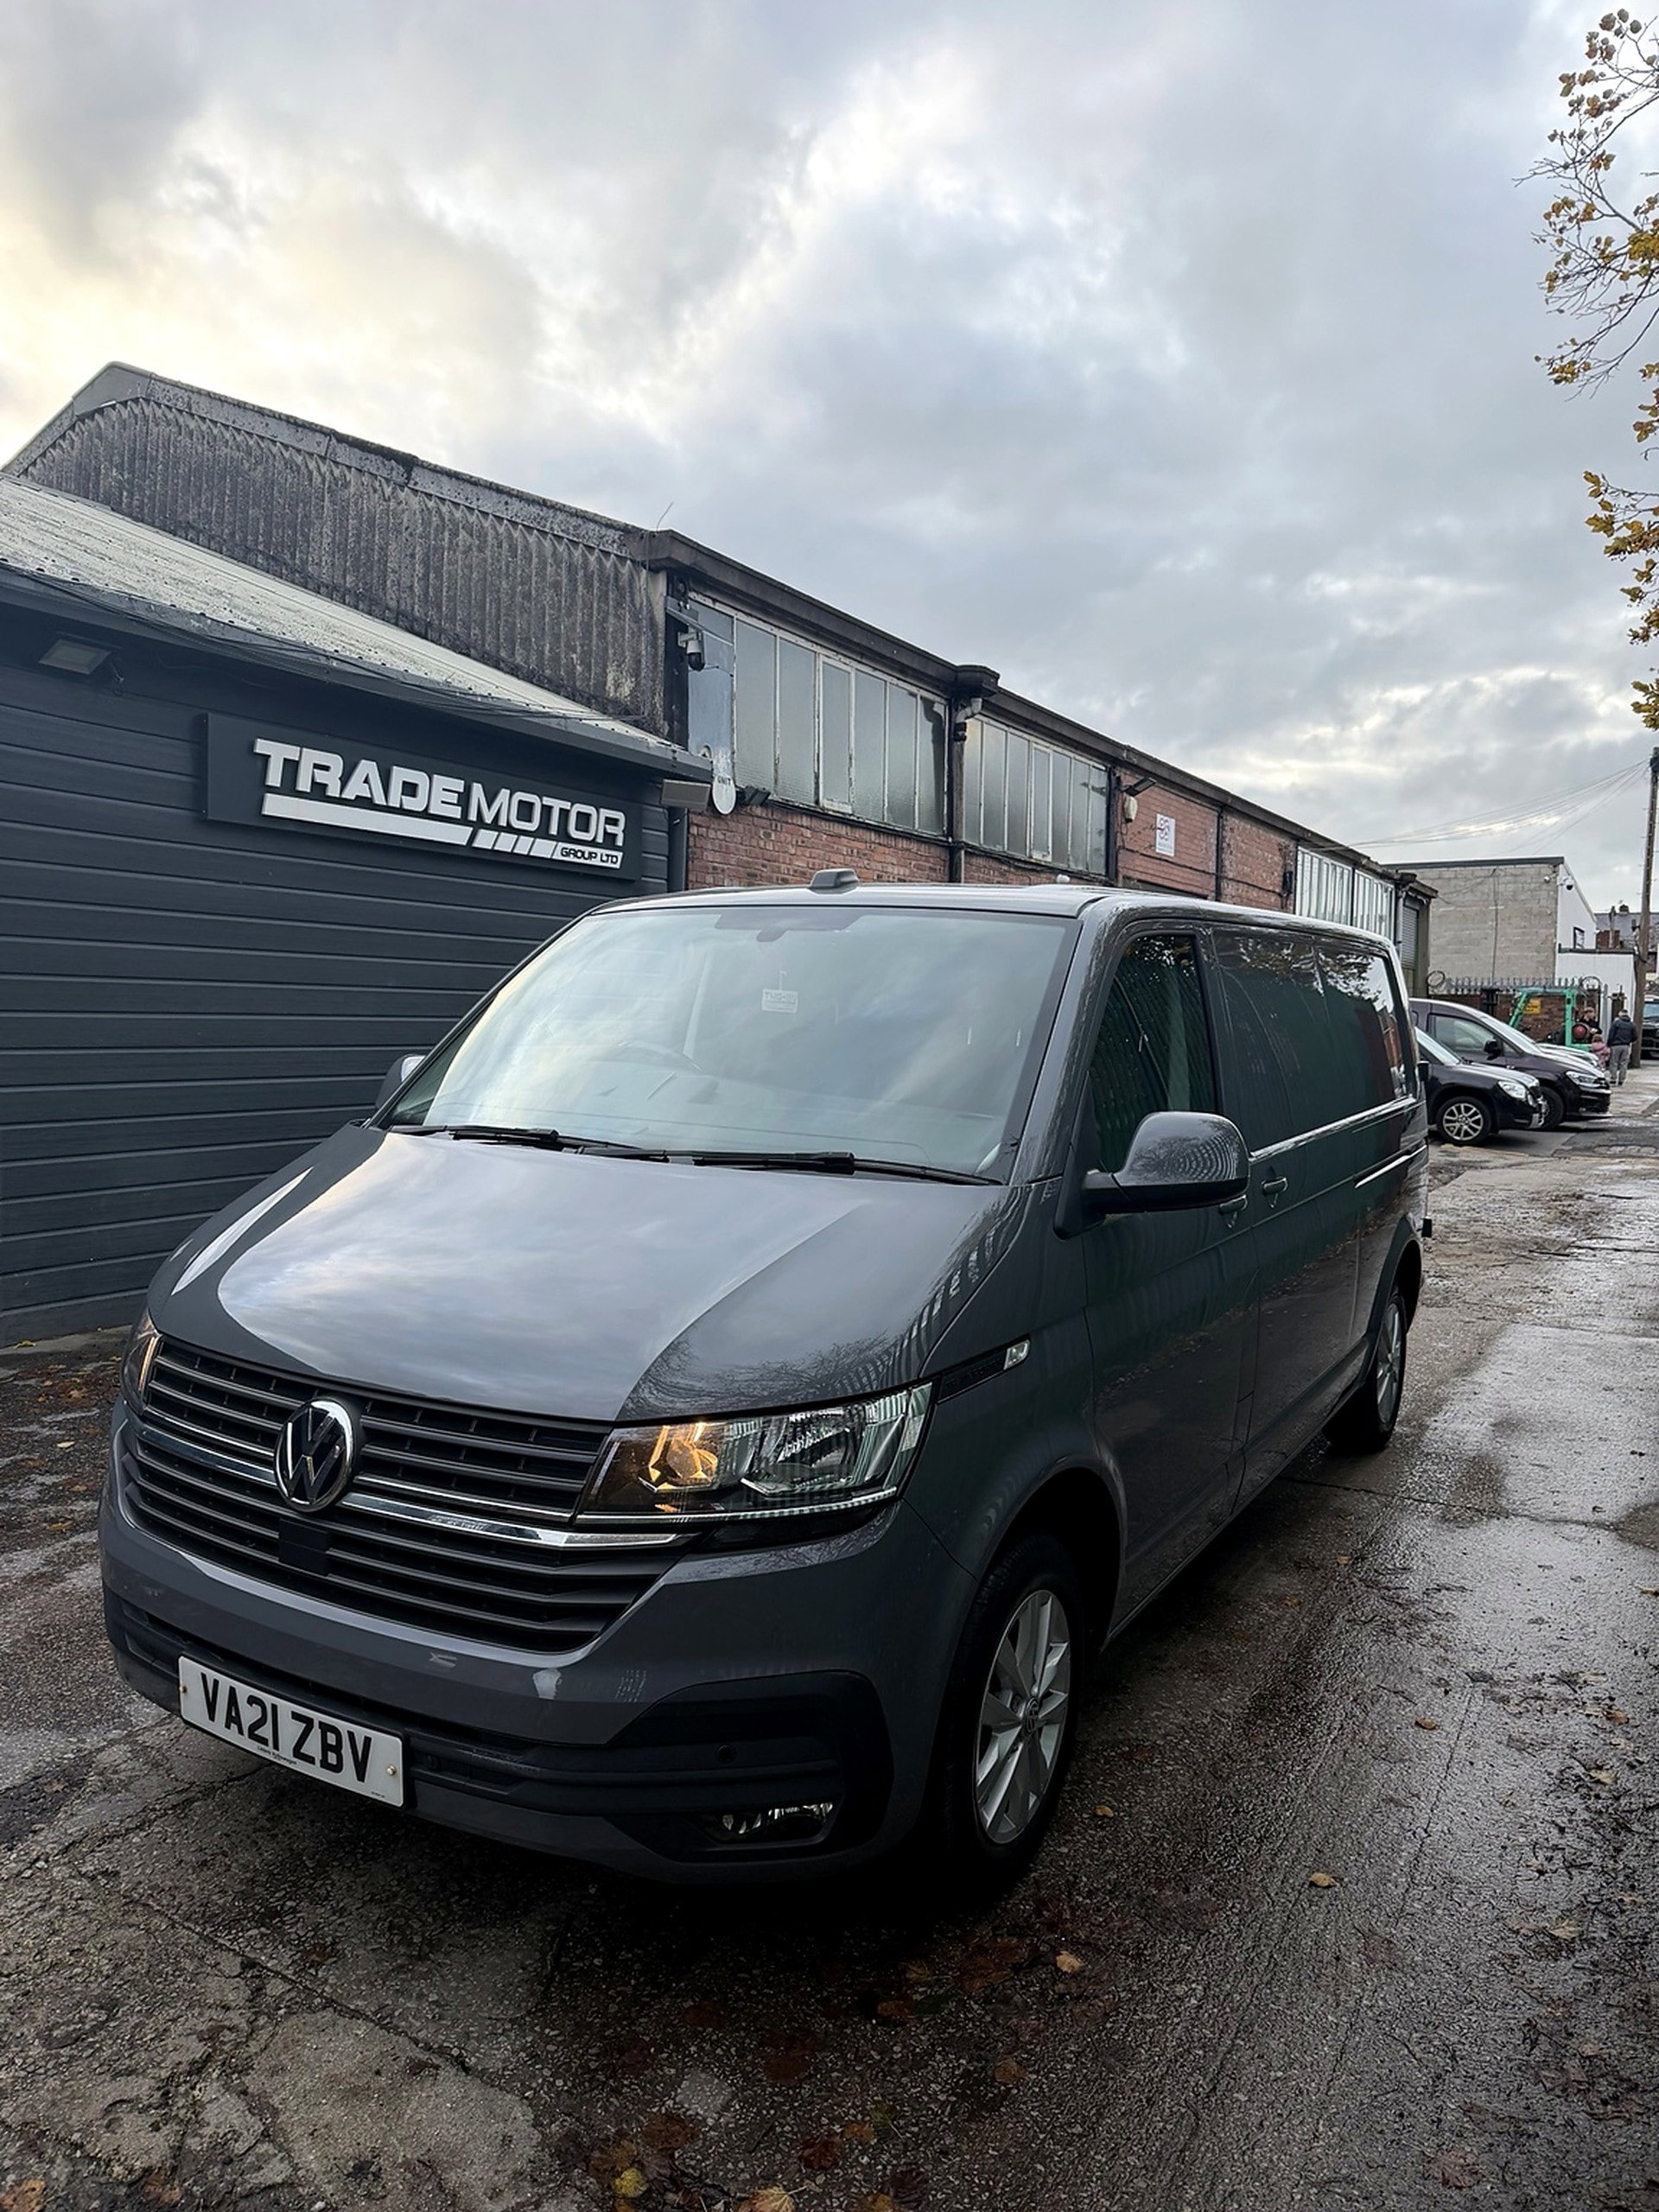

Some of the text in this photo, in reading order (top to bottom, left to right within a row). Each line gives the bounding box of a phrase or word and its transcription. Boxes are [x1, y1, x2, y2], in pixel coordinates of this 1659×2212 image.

[253, 738, 626, 846] TRADE MOTOR
[560, 847, 619, 864] GROUP LTD
[200, 1672, 372, 1783] VA21 ZBV
